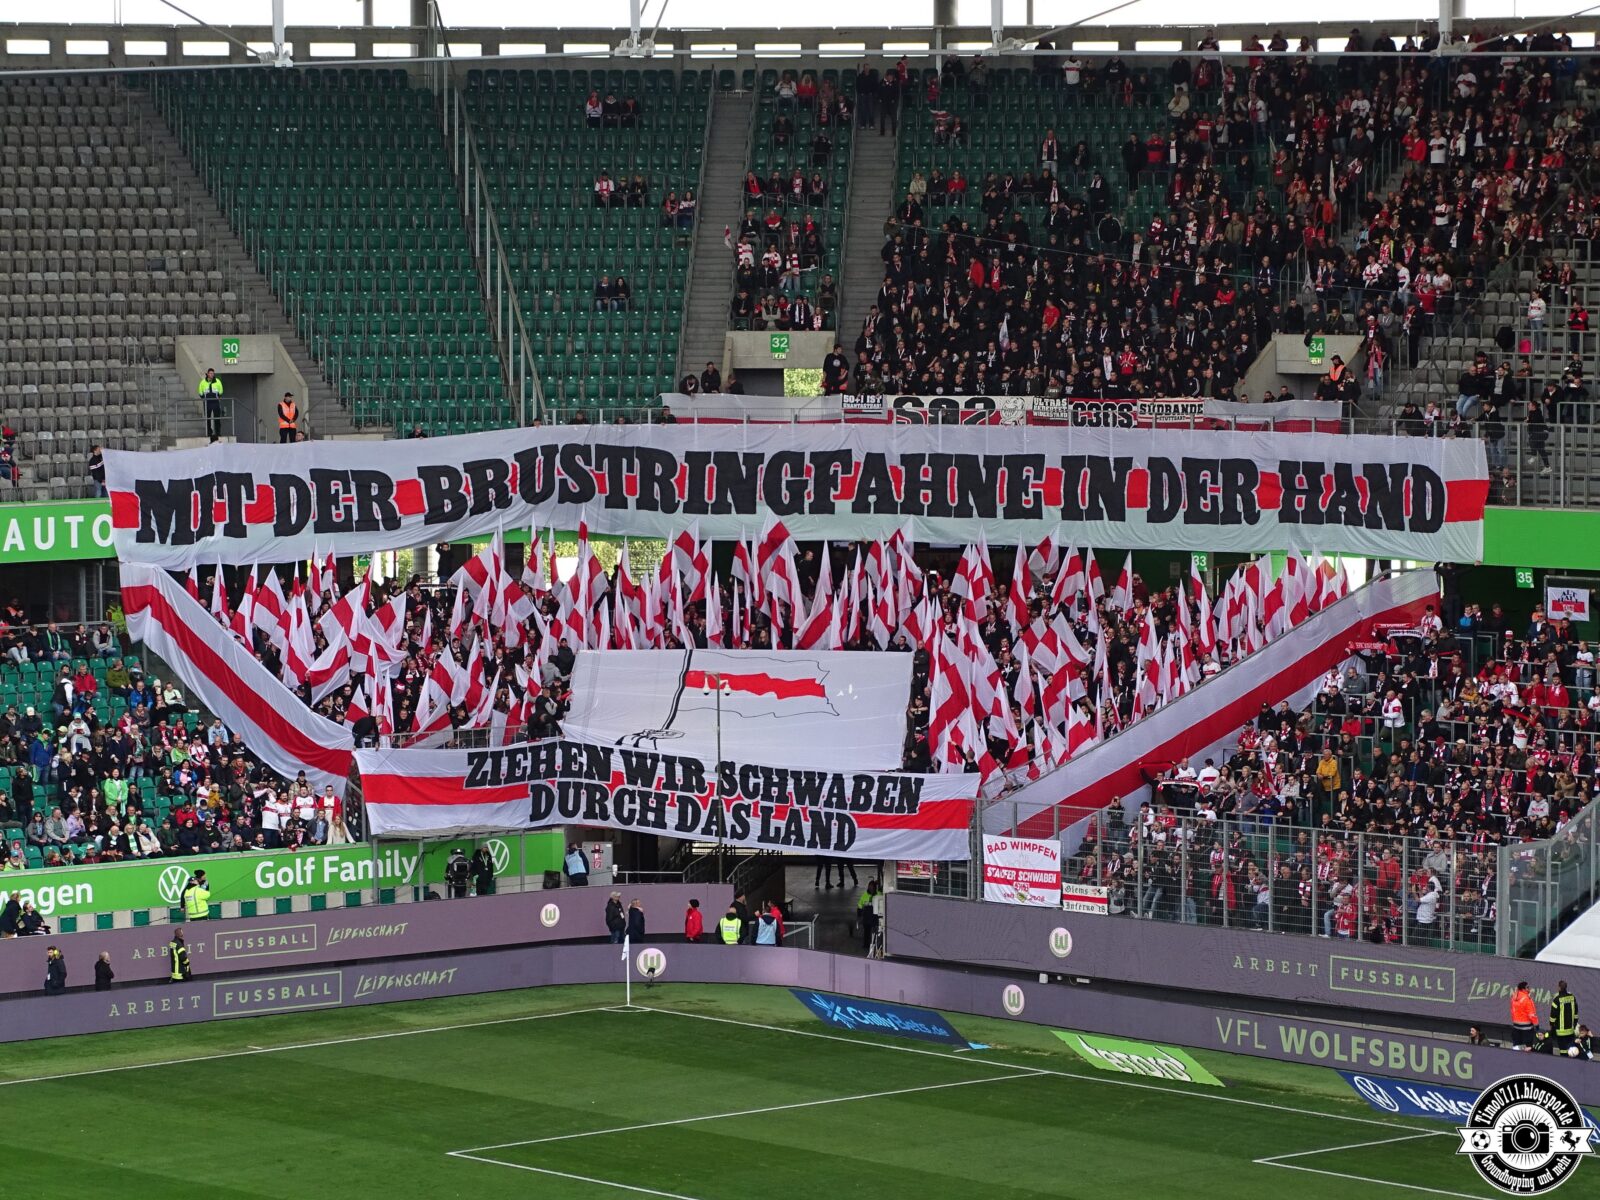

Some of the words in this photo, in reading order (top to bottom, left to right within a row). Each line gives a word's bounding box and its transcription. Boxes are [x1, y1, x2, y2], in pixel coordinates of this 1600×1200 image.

[223, 343, 238, 354] 30
[771, 337, 788, 348] 32
[1309, 342, 1324, 353] 34
[1033, 397, 1067, 406] ULTRAS
[135, 471, 255, 545] MIT
[269, 468, 400, 537] DER
[1061, 455, 1134, 522] IN
[1147, 457, 1261, 525] DER
[1279, 460, 1445, 533] HAND
[3, 513, 113, 552] AUTO
[1193, 555, 1207, 567] 33
[1517, 571, 1532, 584] 35
[465, 739, 613, 788] ZIEHEN
[620, 749, 706, 794] WIR
[716, 760, 924, 814] SCHWABEN
[529, 781, 667, 830] DURCH
[675, 796, 750, 842] DAS
[757, 805, 856, 852] LAND
[987, 841, 1007, 854] BAD
[1010, 841, 1058, 861] WIMPFEN
[255, 857, 316, 889] Golf
[323, 849, 418, 883] Family
[987, 866, 1016, 881] STAUFER
[1017, 871, 1057, 884] SCHWABEN
[1064, 901, 1095, 913] Inferno
[132, 942, 206, 960] ARBIT
[224, 933, 309, 950] FUSSBALL
[1233, 955, 1319, 977] ARBEIT
[1340, 967, 1446, 991] FUSSBALL
[109, 995, 202, 1017] ARBEIT
[225, 982, 332, 1005] FUSSBALL
[1216, 1016, 1268, 1050] VFL
[1279, 1025, 1473, 1080] WOLFSBURG
